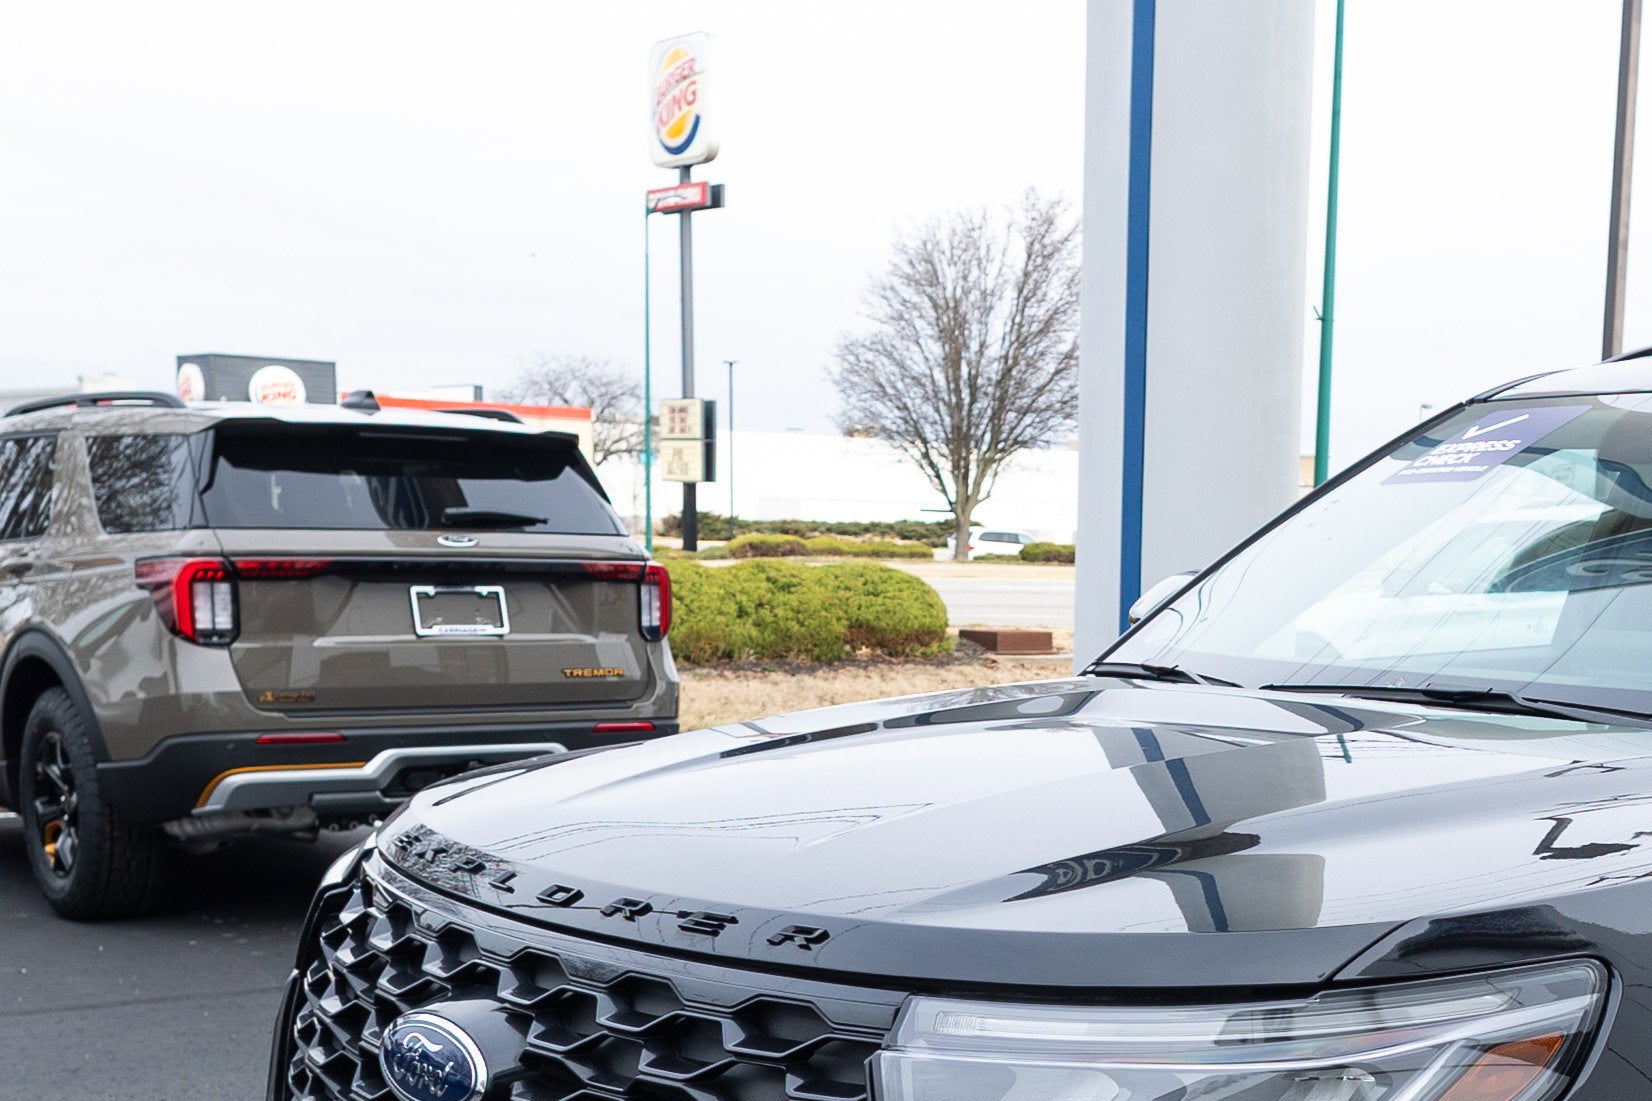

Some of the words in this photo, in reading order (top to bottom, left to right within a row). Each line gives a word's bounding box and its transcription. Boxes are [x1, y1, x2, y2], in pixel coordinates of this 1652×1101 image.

[1430, 440, 1521, 455] EXPRESS
[1412, 453, 1481, 467] CHECK
[562, 666, 624, 679] TREMOR
[391, 831, 832, 951] EXPLORER
[393, 1030, 455, 1098] Ford
